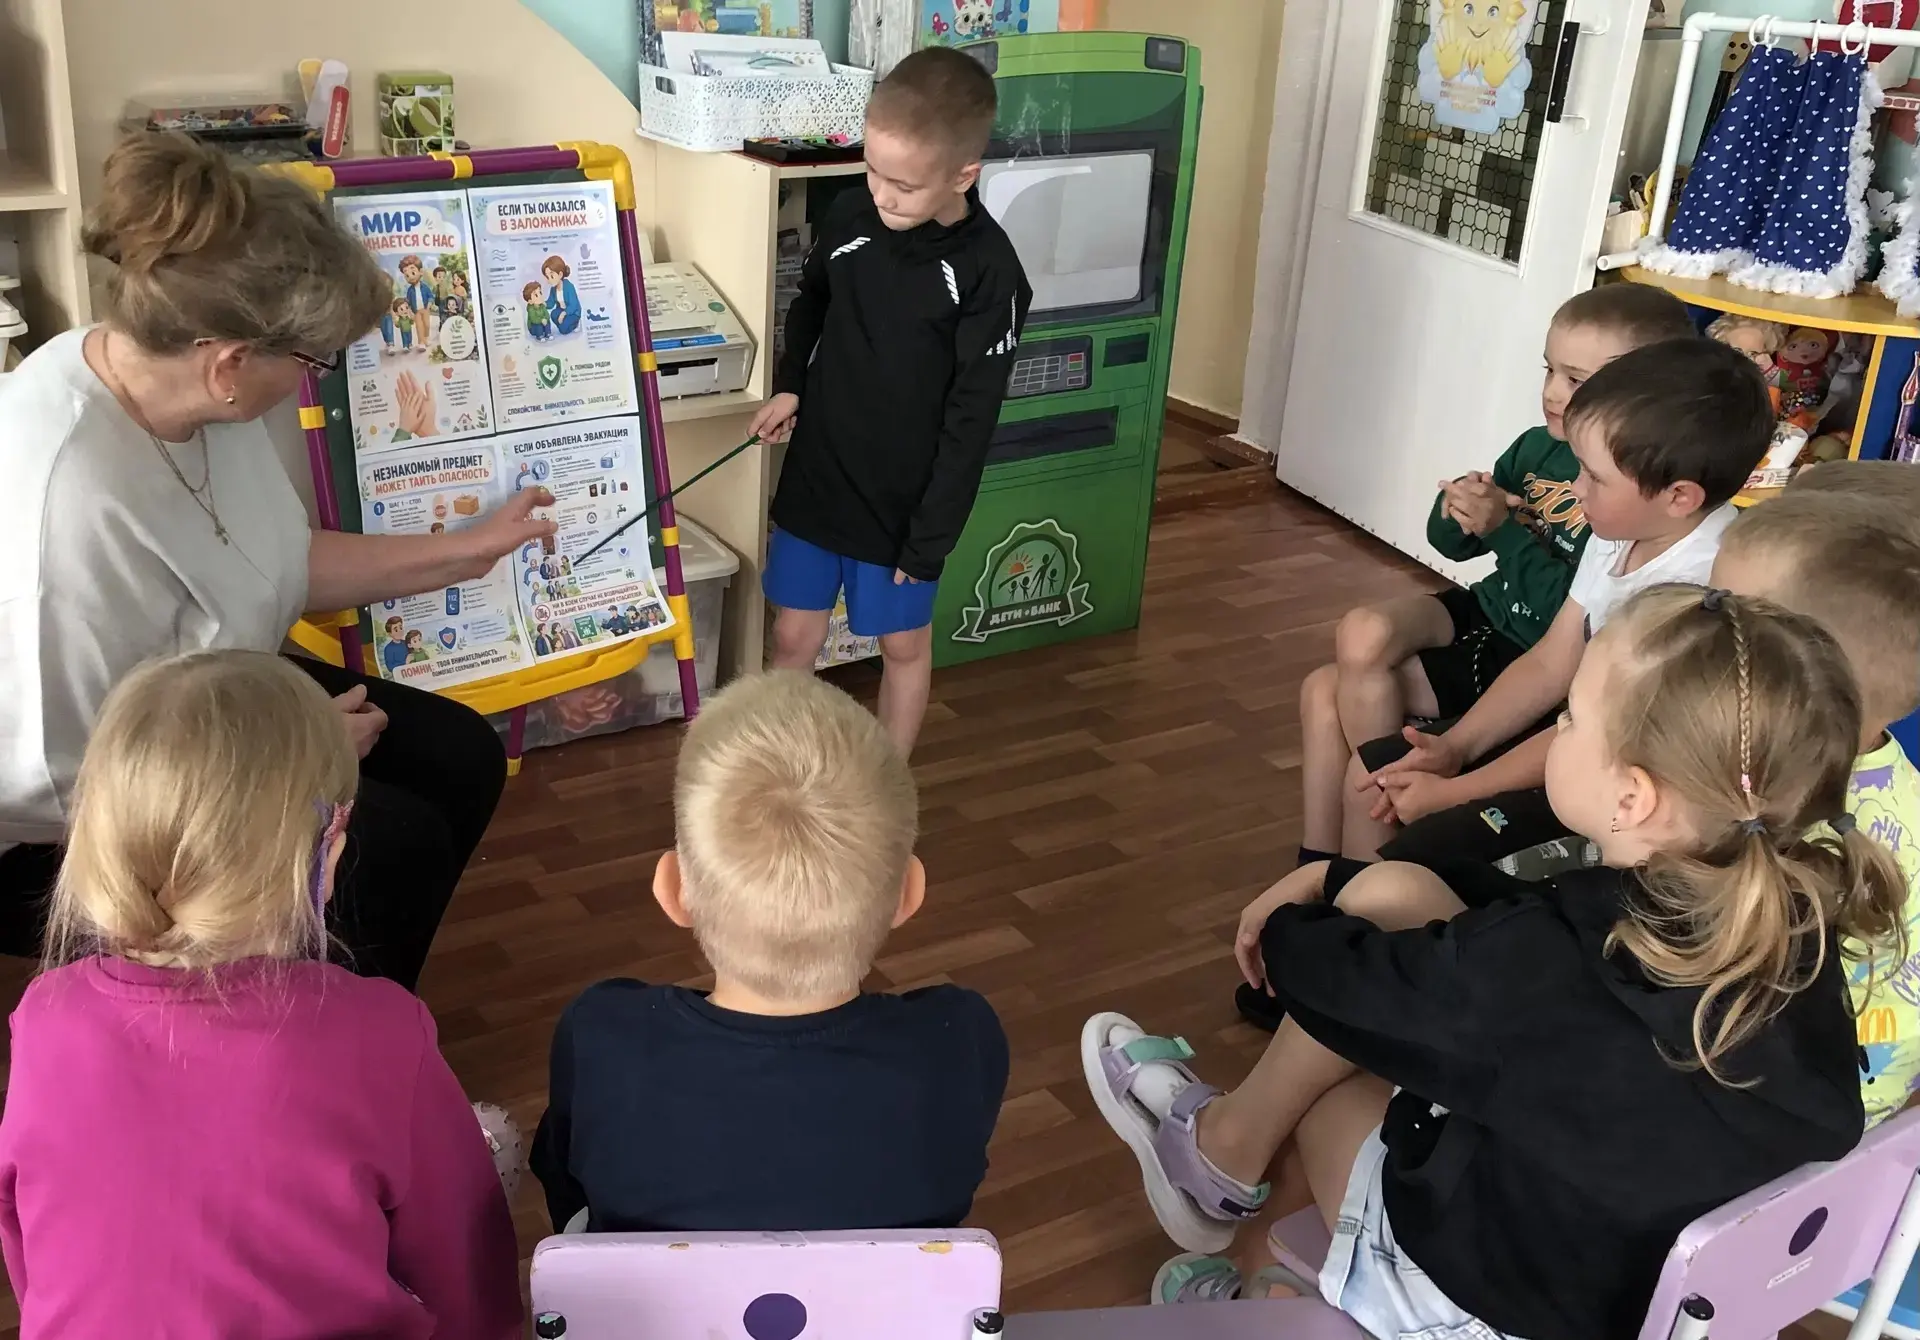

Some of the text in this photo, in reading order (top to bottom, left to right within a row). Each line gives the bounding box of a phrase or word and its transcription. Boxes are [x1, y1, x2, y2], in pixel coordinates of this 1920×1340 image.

[498, 200, 586, 216] ЕСЛИ ТЫ ОКАЗАЛСЯ
[361, 211, 422, 236] МИР
[500, 214, 588, 231] В ЗАЛОЖНИКАХ
[363, 234, 455, 250] ИНАЕТСЯ С НАС
[514, 442, 533, 454] ЕСЛИ
[536, 434, 582, 450] ОБЪЯВЛЕНА
[584, 428, 628, 442] ЭВАКУАЦИЯ
[373, 455, 483, 482] НЕЗНАКОМЫЙ ПРЕДМЕТ
[375, 468, 489, 495] МОЖЕТ ТАИТЬ ОПАСНОСТЬ
[990, 601, 1061, 626] ДЕТИ БАНК
[400, 664, 435, 679] ПОМНИ:
[436, 658, 451, 669] ТВОЯ
